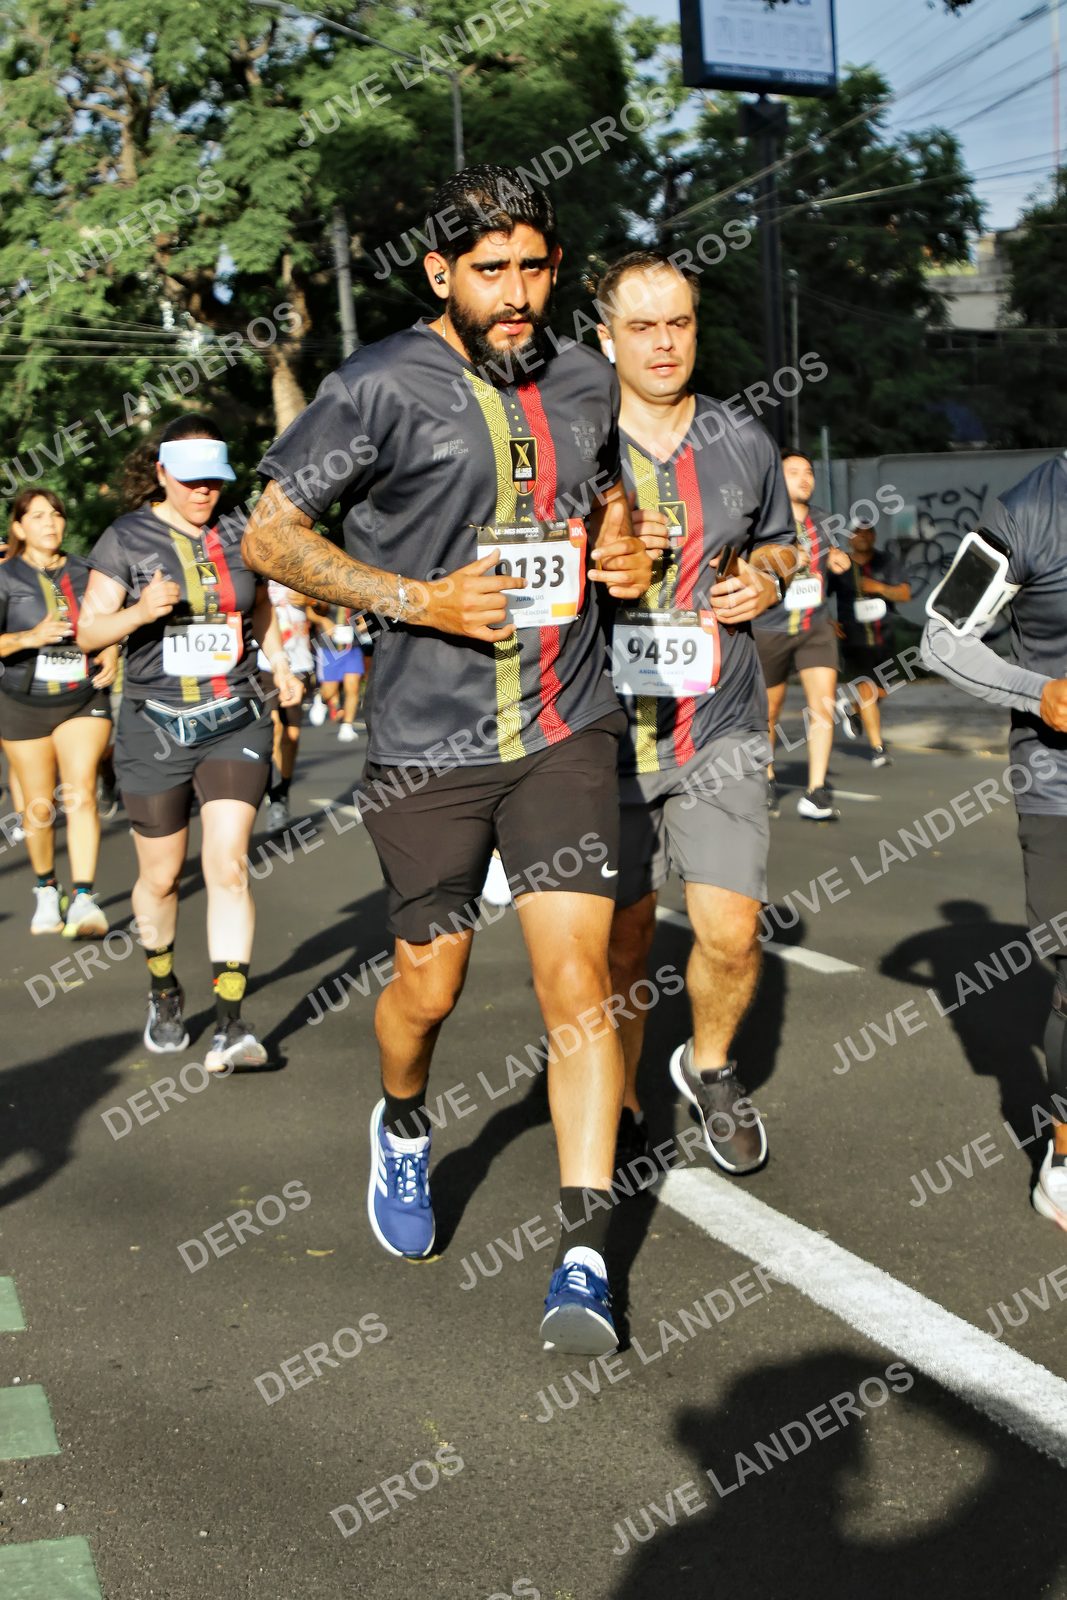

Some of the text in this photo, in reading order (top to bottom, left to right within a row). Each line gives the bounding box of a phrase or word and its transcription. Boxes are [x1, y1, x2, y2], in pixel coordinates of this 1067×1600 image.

[917, 484, 988, 512] TOY
[169, 633, 231, 653] 11622
[627, 637, 697, 665] 9459
